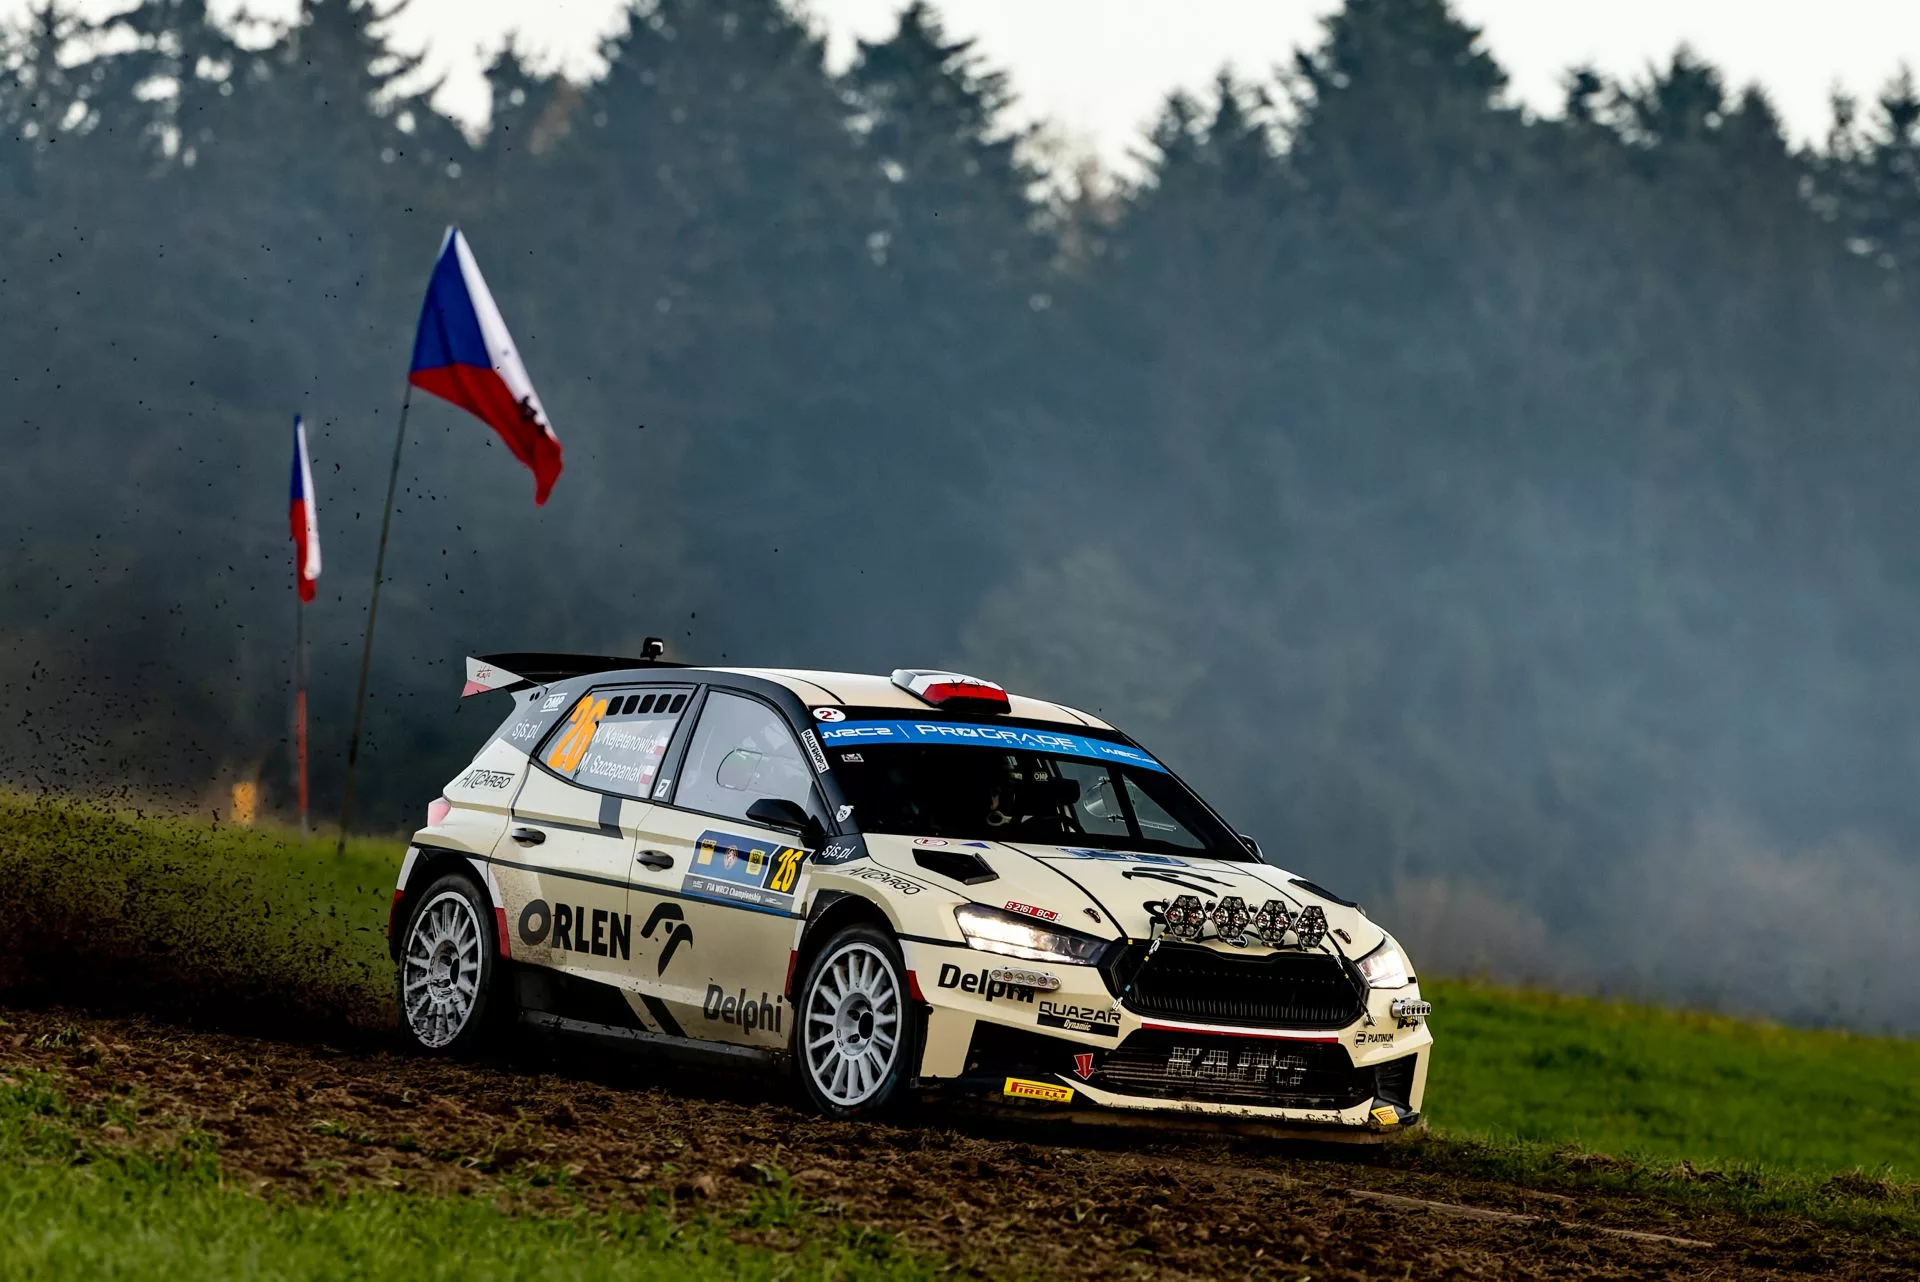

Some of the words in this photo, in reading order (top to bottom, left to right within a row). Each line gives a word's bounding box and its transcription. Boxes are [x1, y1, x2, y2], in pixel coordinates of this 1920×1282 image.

[543, 695, 566, 710] OMP
[512, 719, 542, 739] sjs.pl
[547, 695, 608, 773] 26
[915, 724, 1076, 748] PROGRADE
[822, 842, 856, 859] sjs.pl
[770, 848, 804, 893] 26
[518, 899, 631, 960] ORLEN
[703, 984, 783, 1036] Delphi
[1039, 1001, 1122, 1024] QUAZAR
[1063, 1019, 1092, 1031] Dynamic
[1367, 1033, 1394, 1043] PLATINUM
[1011, 1082, 1067, 1098] PIRELLI
